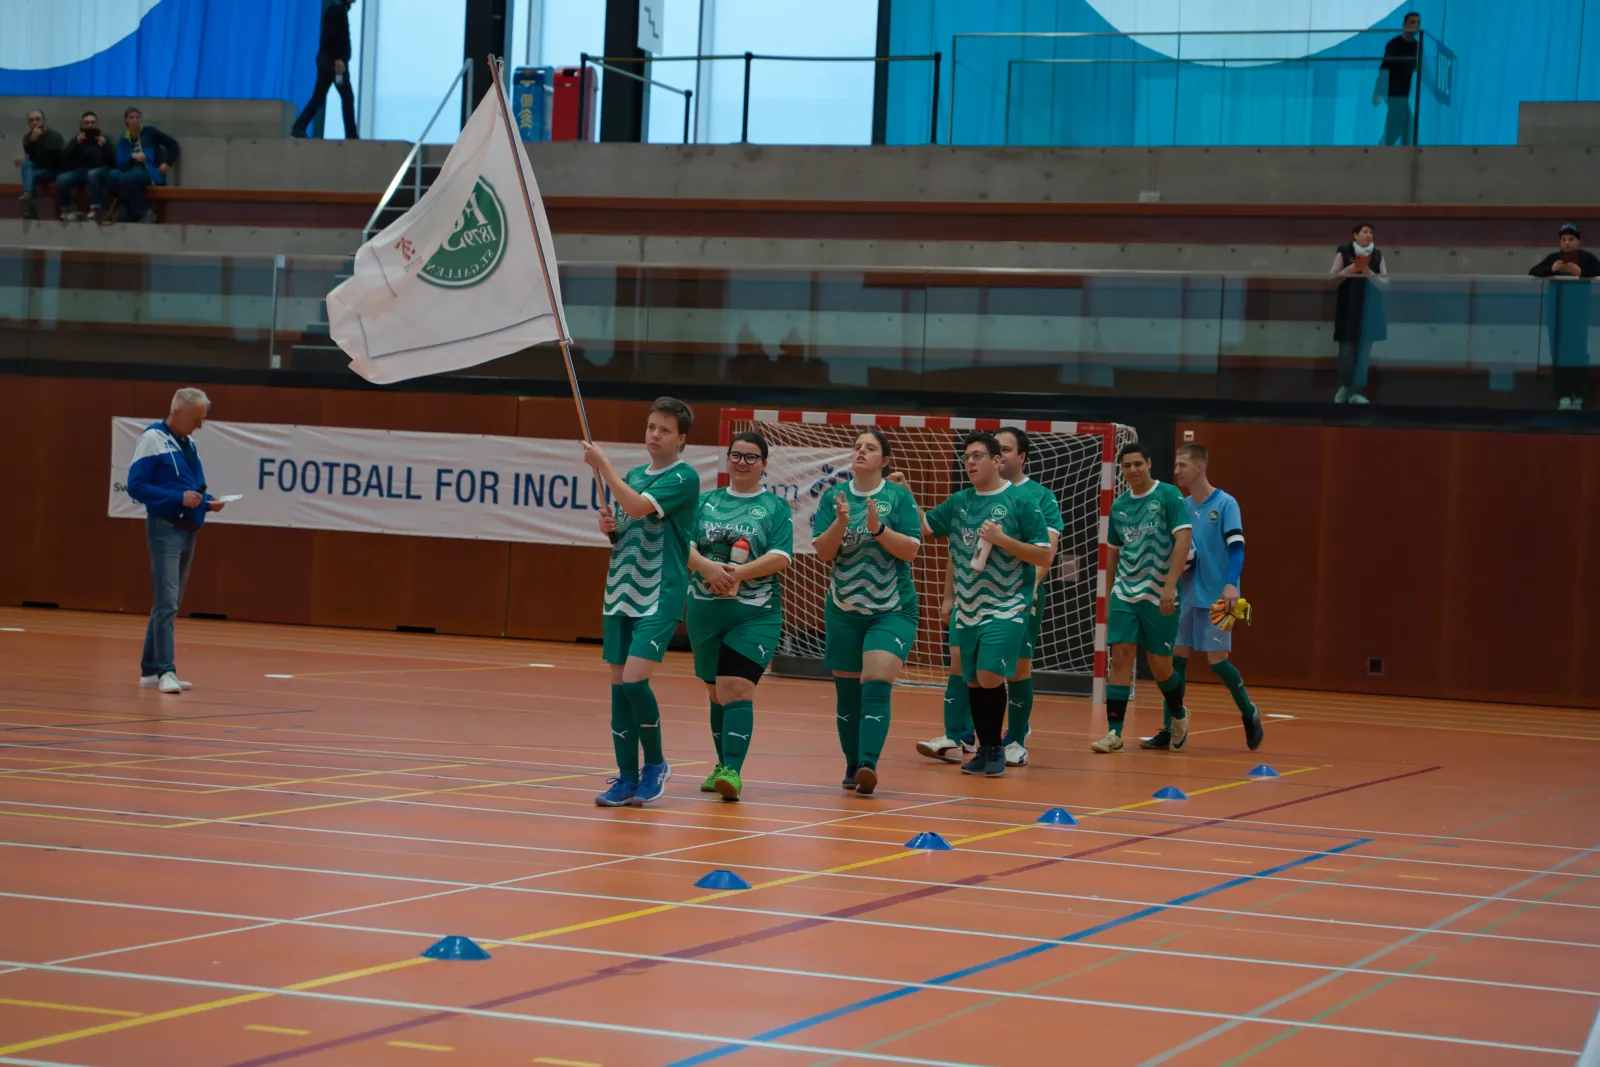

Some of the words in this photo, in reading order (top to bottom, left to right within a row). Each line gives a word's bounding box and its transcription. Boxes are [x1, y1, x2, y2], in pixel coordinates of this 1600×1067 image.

[258, 457, 422, 501] FOOTBALL
[435, 468, 500, 505] FOR
[513, 472, 625, 511] INCLU
